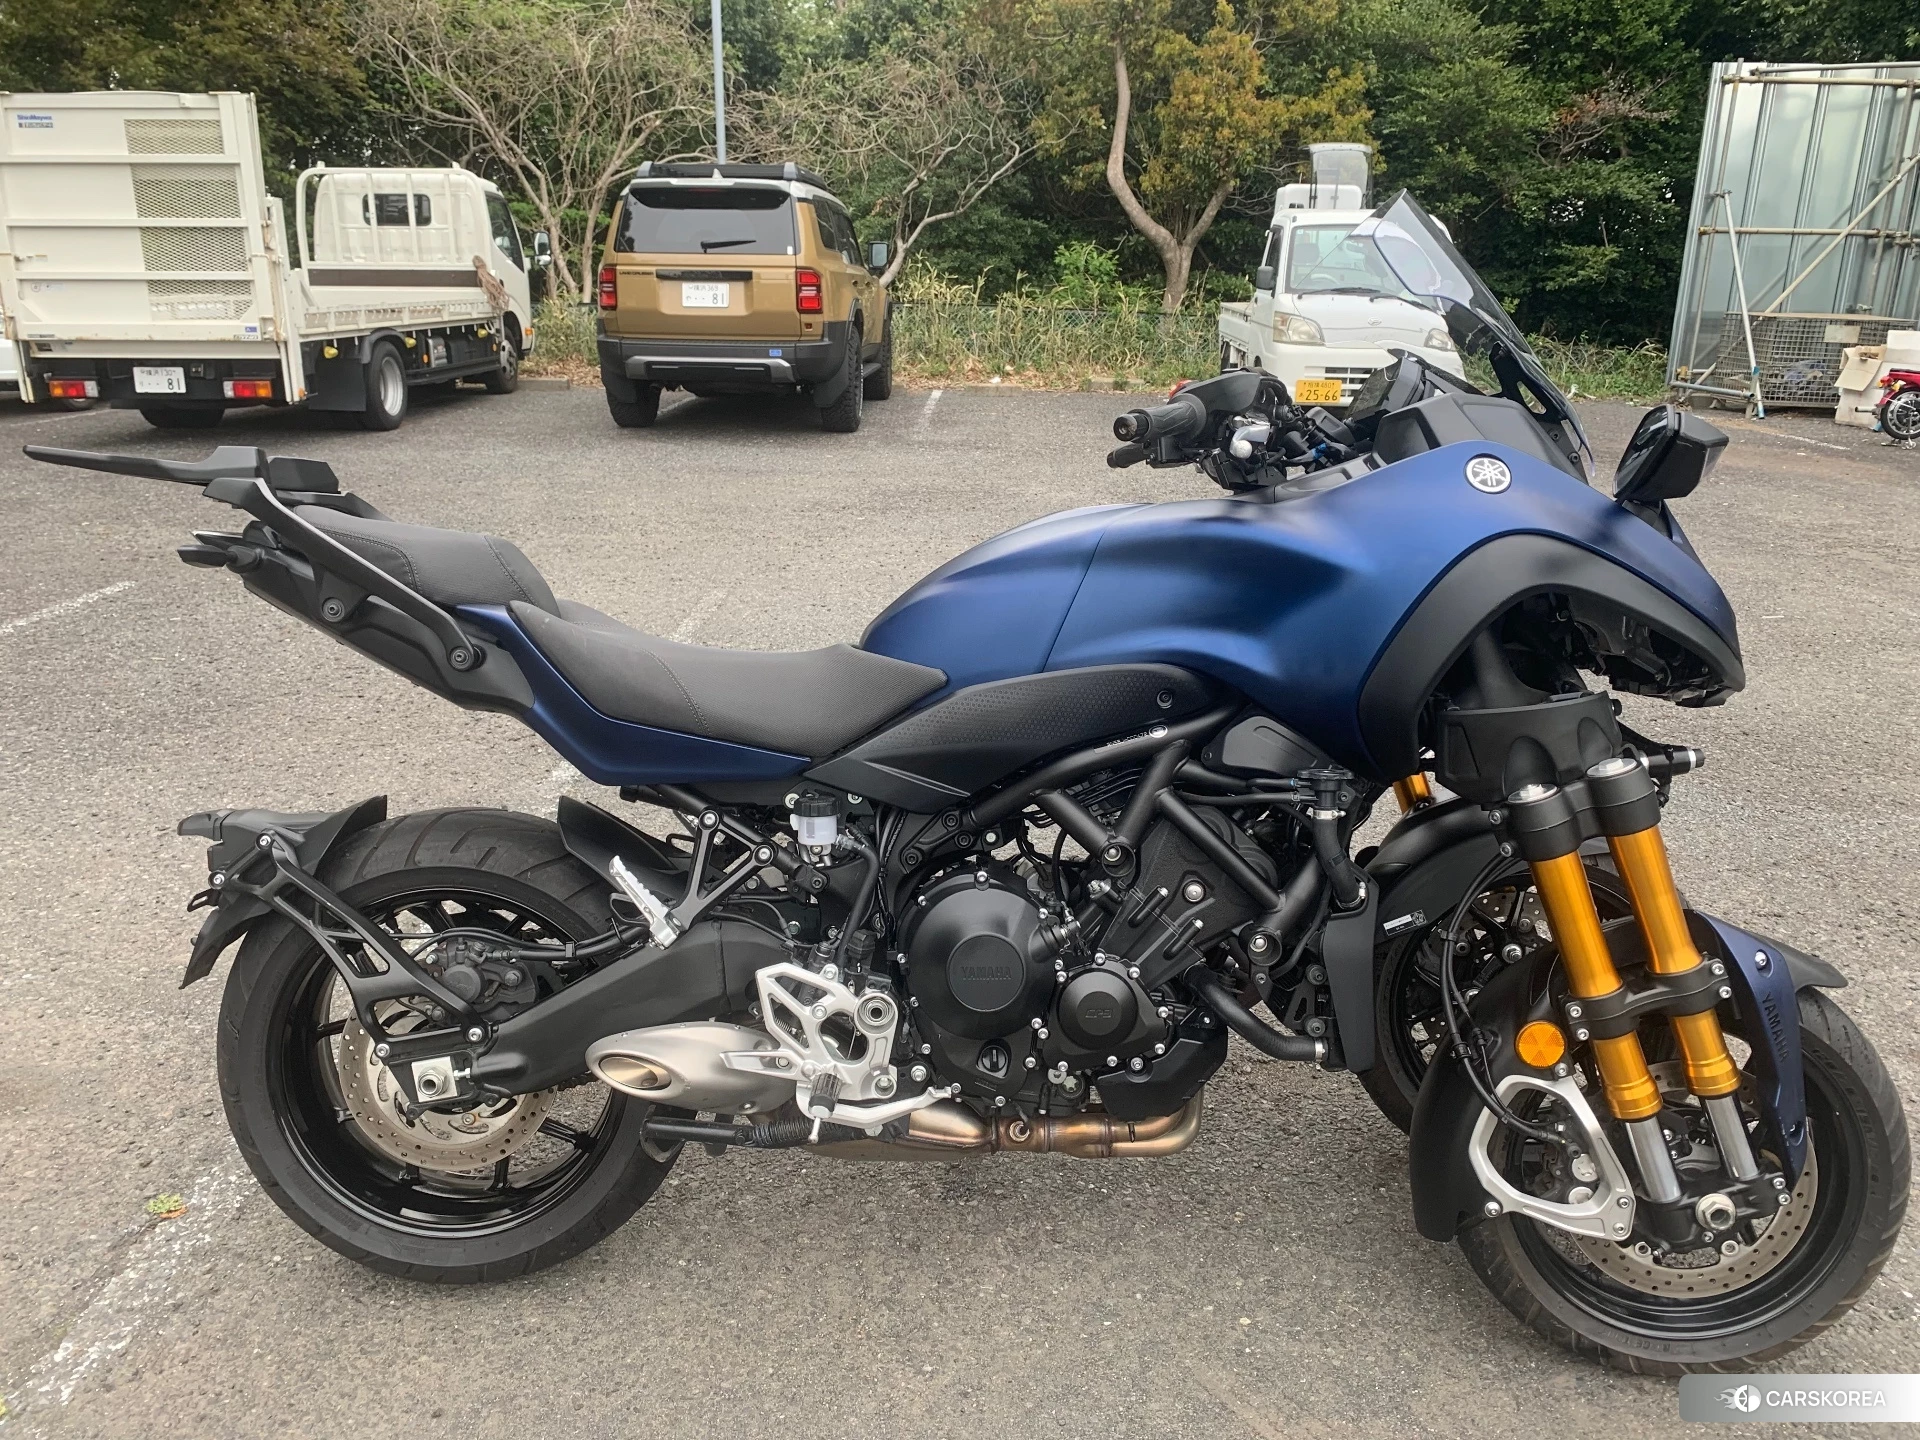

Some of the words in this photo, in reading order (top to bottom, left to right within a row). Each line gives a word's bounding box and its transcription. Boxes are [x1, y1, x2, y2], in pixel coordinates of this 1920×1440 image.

[1305, 389, 1338, 401] 25-66
[960, 966, 1012, 981] YAMAHA
[1762, 991, 1789, 1063] YAMAHA
